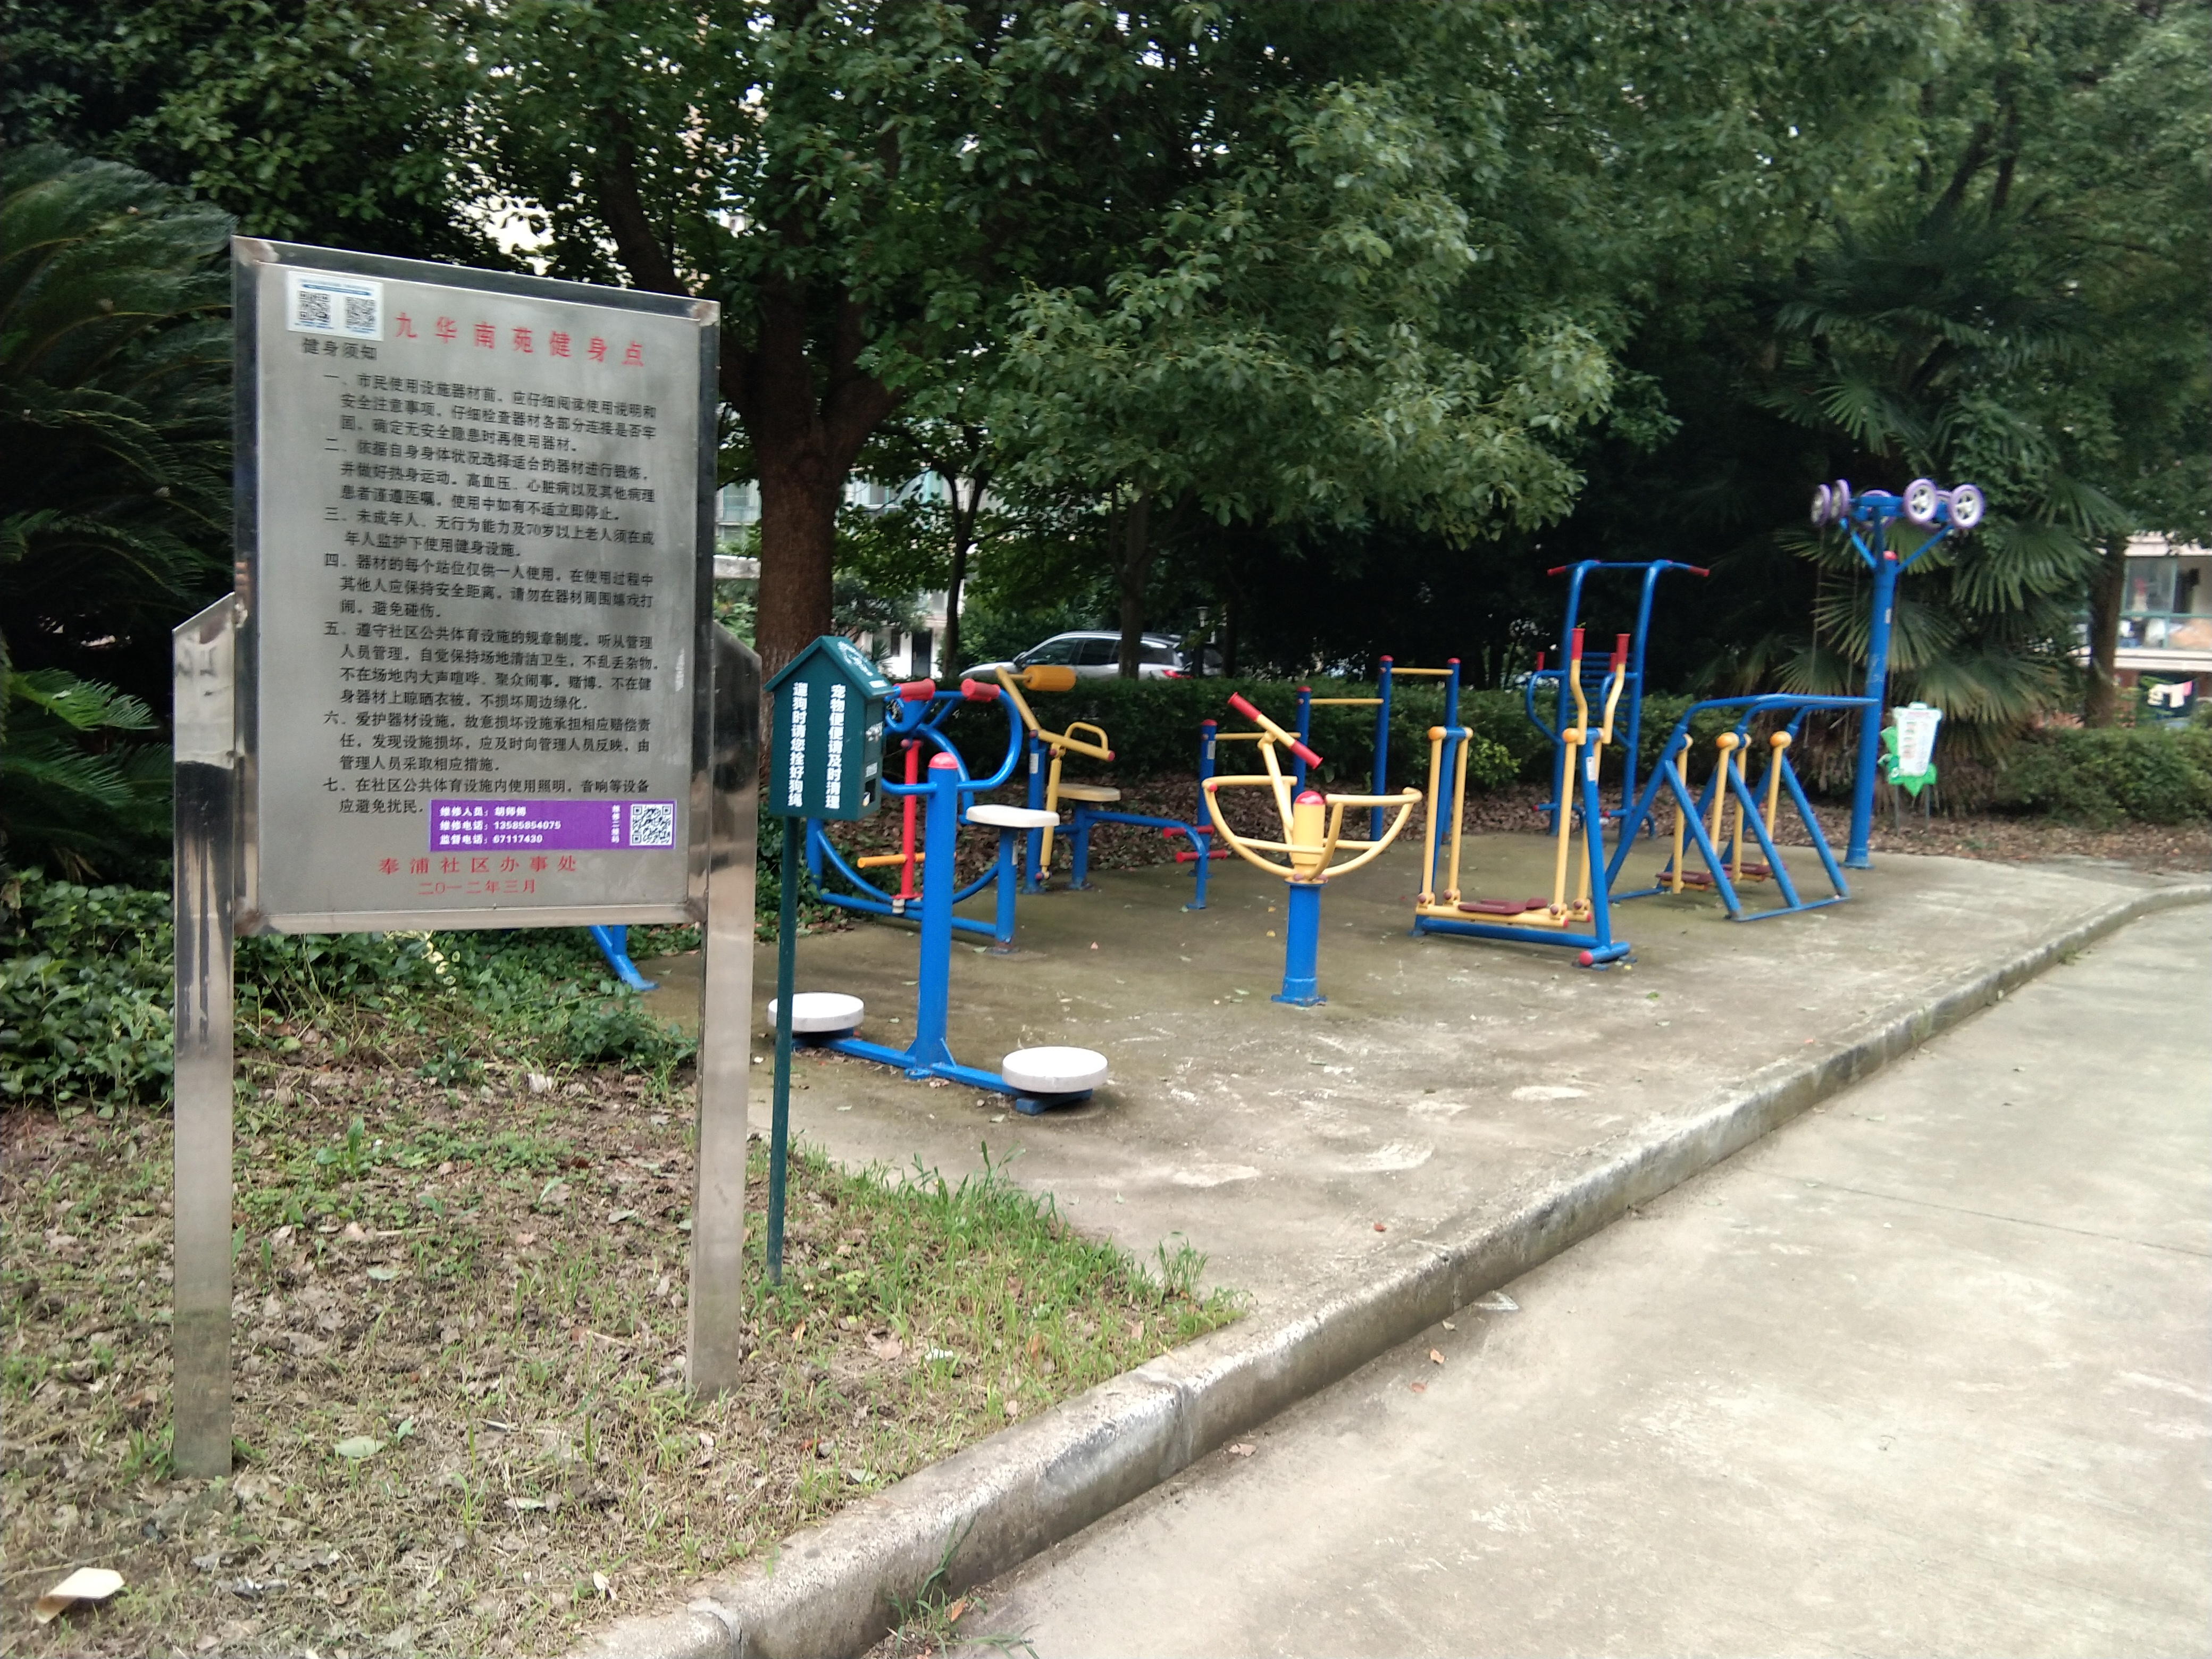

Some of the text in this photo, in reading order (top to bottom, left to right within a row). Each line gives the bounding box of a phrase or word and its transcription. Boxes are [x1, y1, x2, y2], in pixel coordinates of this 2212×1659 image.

[303, 337, 377, 360] 健身须知
[395, 312, 643, 367] 九华南苑健身点
[787, 682, 808, 807] 遛狗时请您拴好狗绳
[825, 684, 846, 809] 宠物便便请及时清理
[378, 856, 577, 875] 奉浦社区办事处
